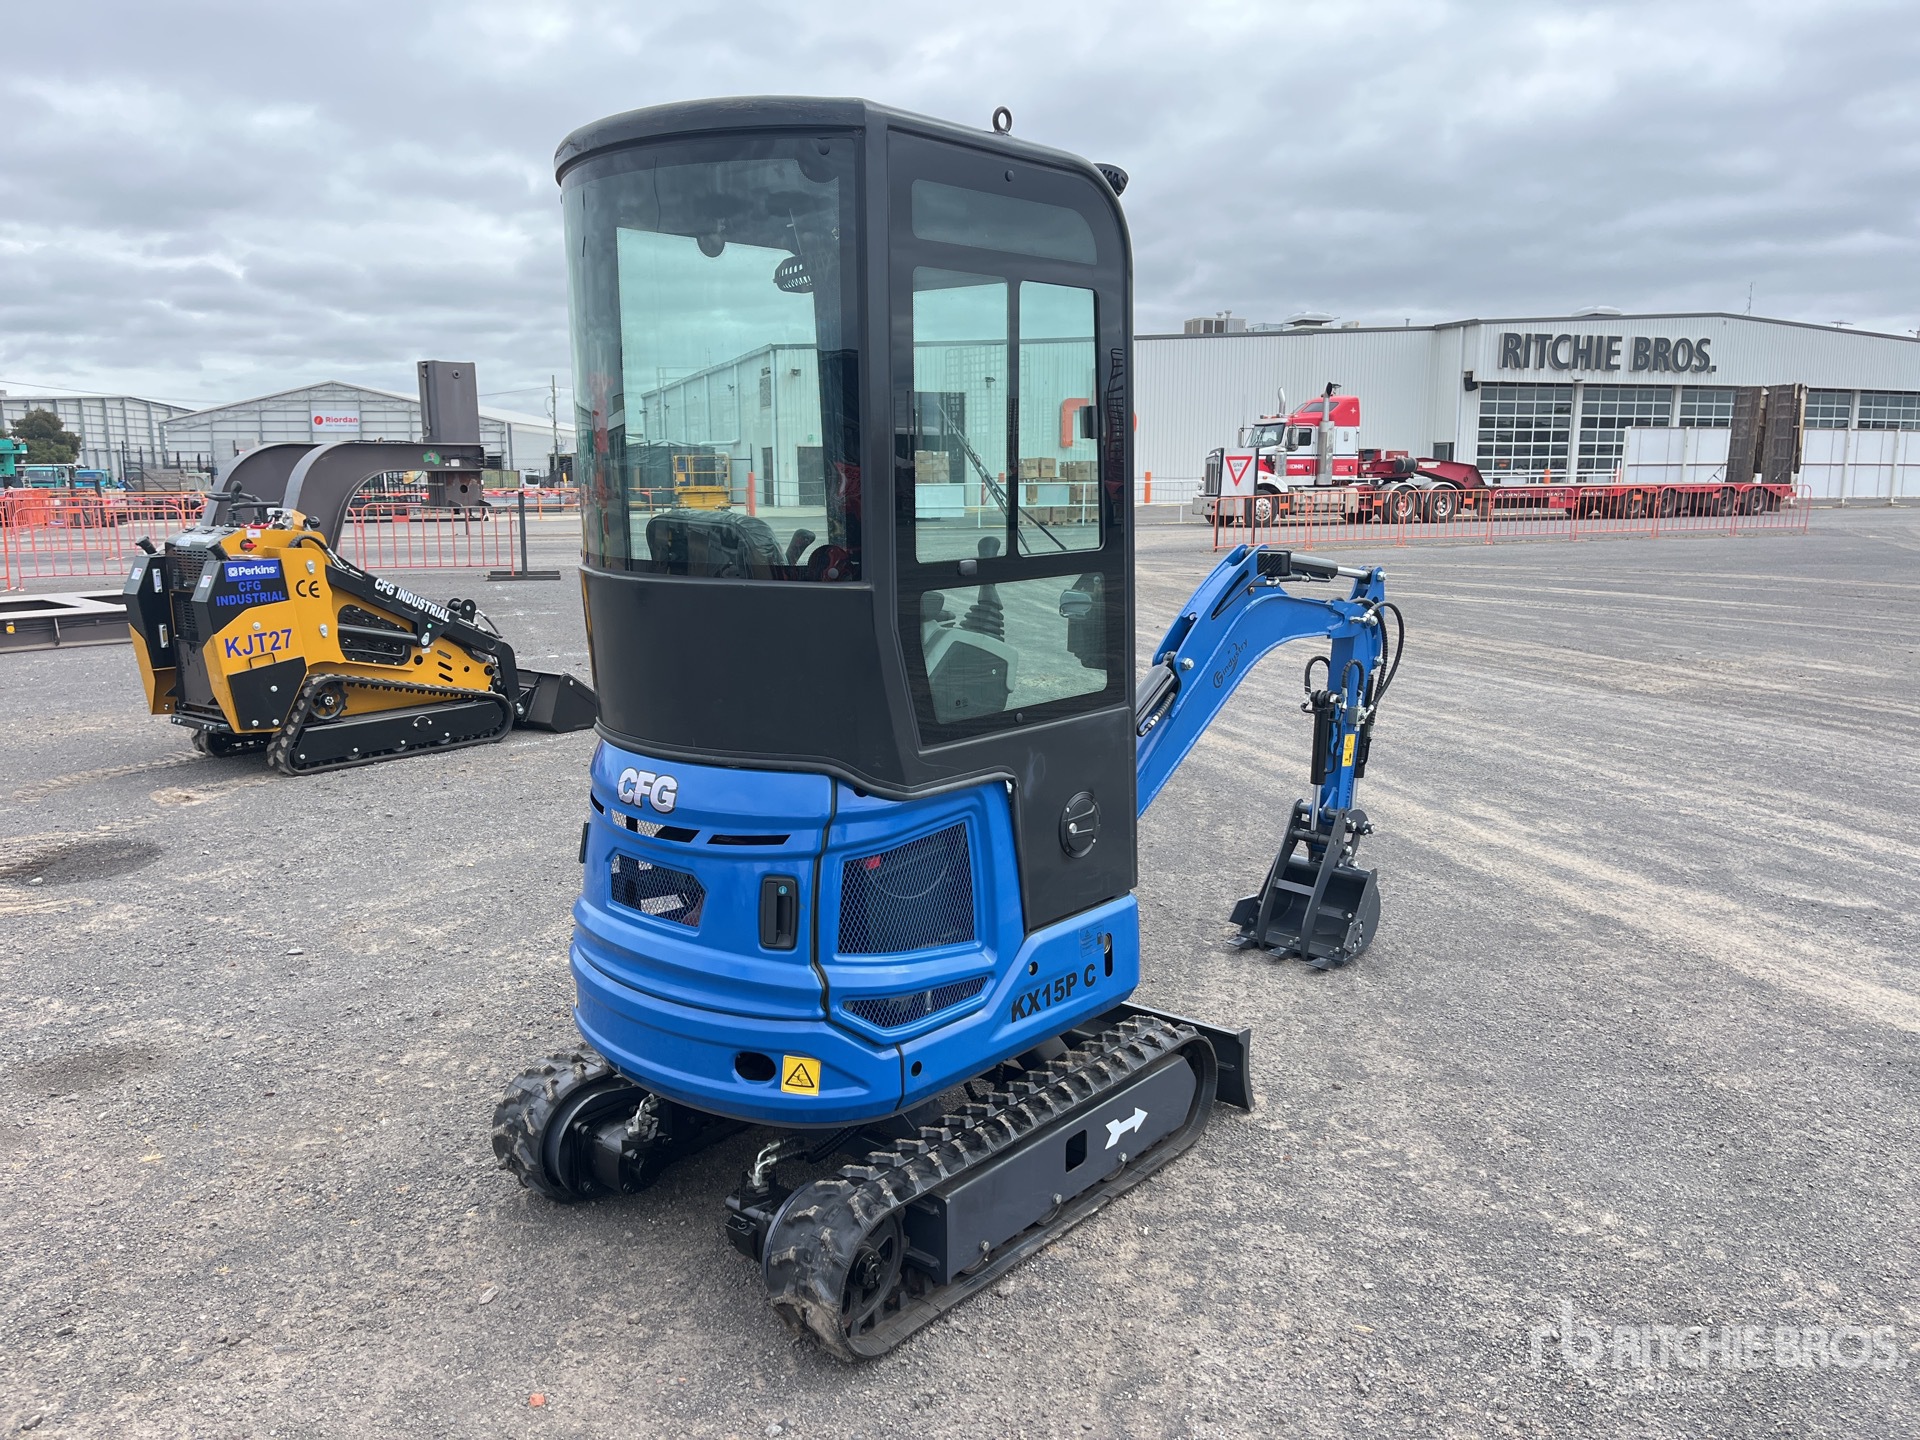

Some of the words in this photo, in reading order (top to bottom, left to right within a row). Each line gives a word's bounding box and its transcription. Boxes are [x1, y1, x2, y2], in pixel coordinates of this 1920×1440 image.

[1499, 332, 1623, 370] RITCHIE
[1629, 336, 1717, 373] BROS.
[238, 565, 277, 576] Perkins
[216, 591, 286, 607] INDUSTRIAL
[238, 580, 262, 592] CFG
[295, 579, 321, 598] CE
[374, 578, 396, 595] CFG
[395, 587, 450, 623] INDUSTRIAL
[224, 628, 292, 658] KJT27
[617, 766, 679, 814] CFG
[1011, 972, 1078, 1024] KX15P
[1083, 963, 1097, 988] C
